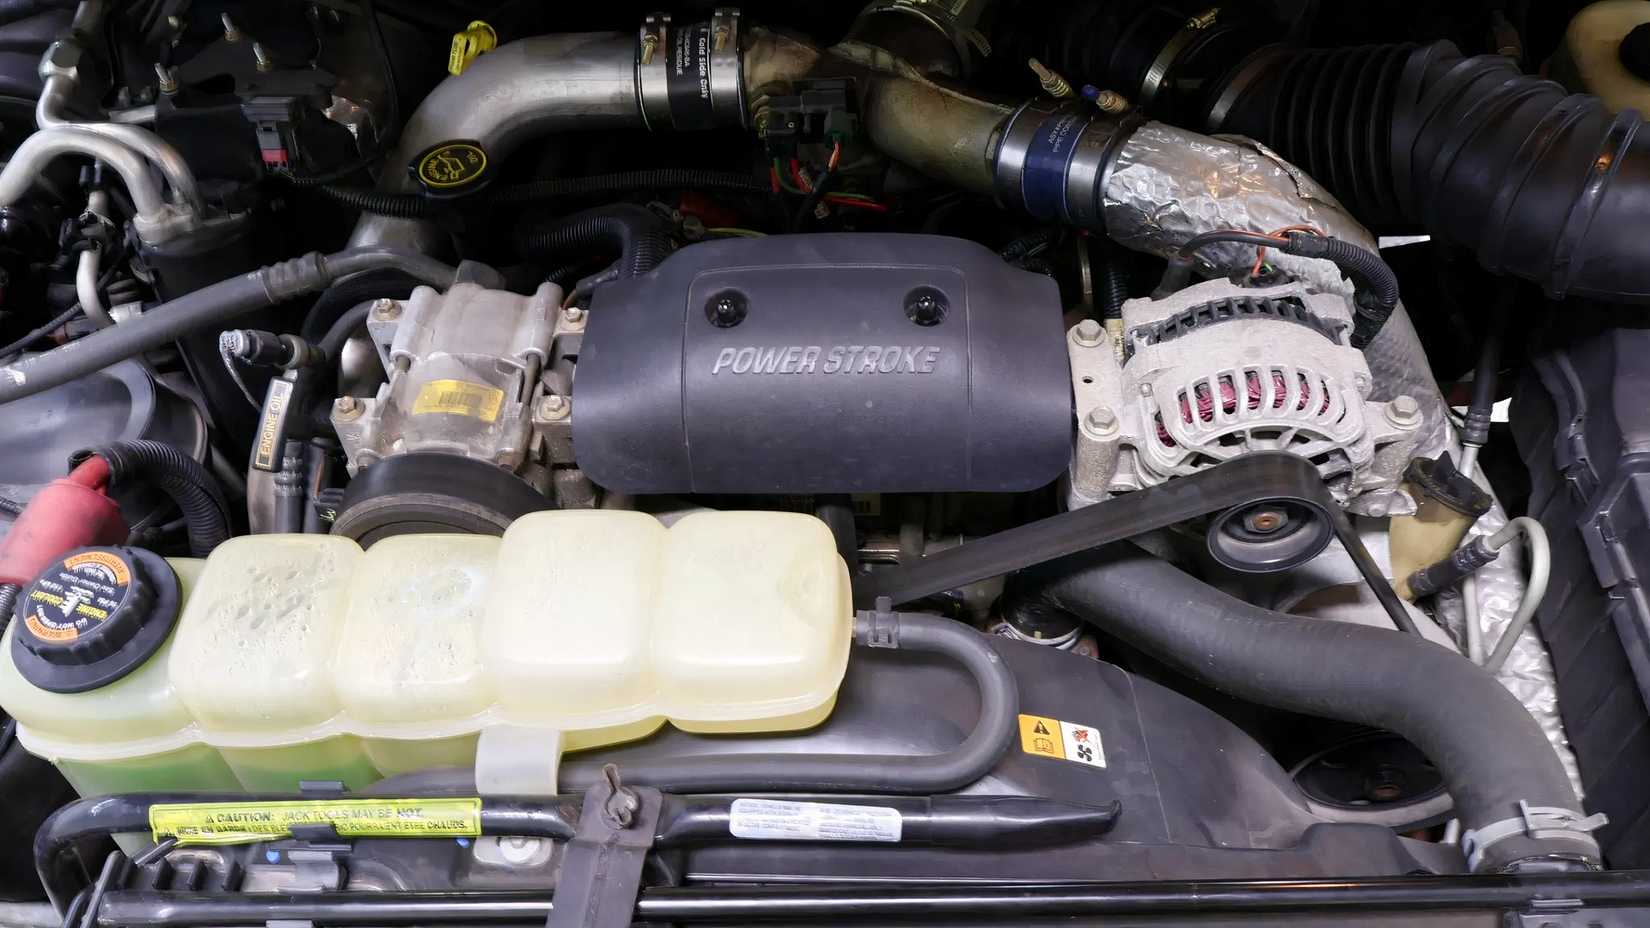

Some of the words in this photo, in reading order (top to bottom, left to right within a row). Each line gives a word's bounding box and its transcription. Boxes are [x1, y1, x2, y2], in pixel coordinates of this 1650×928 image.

[699, 57, 707, 76] Side
[700, 79, 709, 99] Only
[711, 346, 822, 375] POWER
[823, 345, 940, 374] STROKE
[261, 414, 278, 455] ENGINE
[270, 392, 283, 411] OIL
[30, 590, 64, 607] COOLANT
[75, 603, 108, 621] ENGINE
[216, 811, 275, 823] CAUTION:
[281, 810, 311, 822] JACK
[351, 808, 377, 819] MAY
[378, 808, 392, 818] BE
